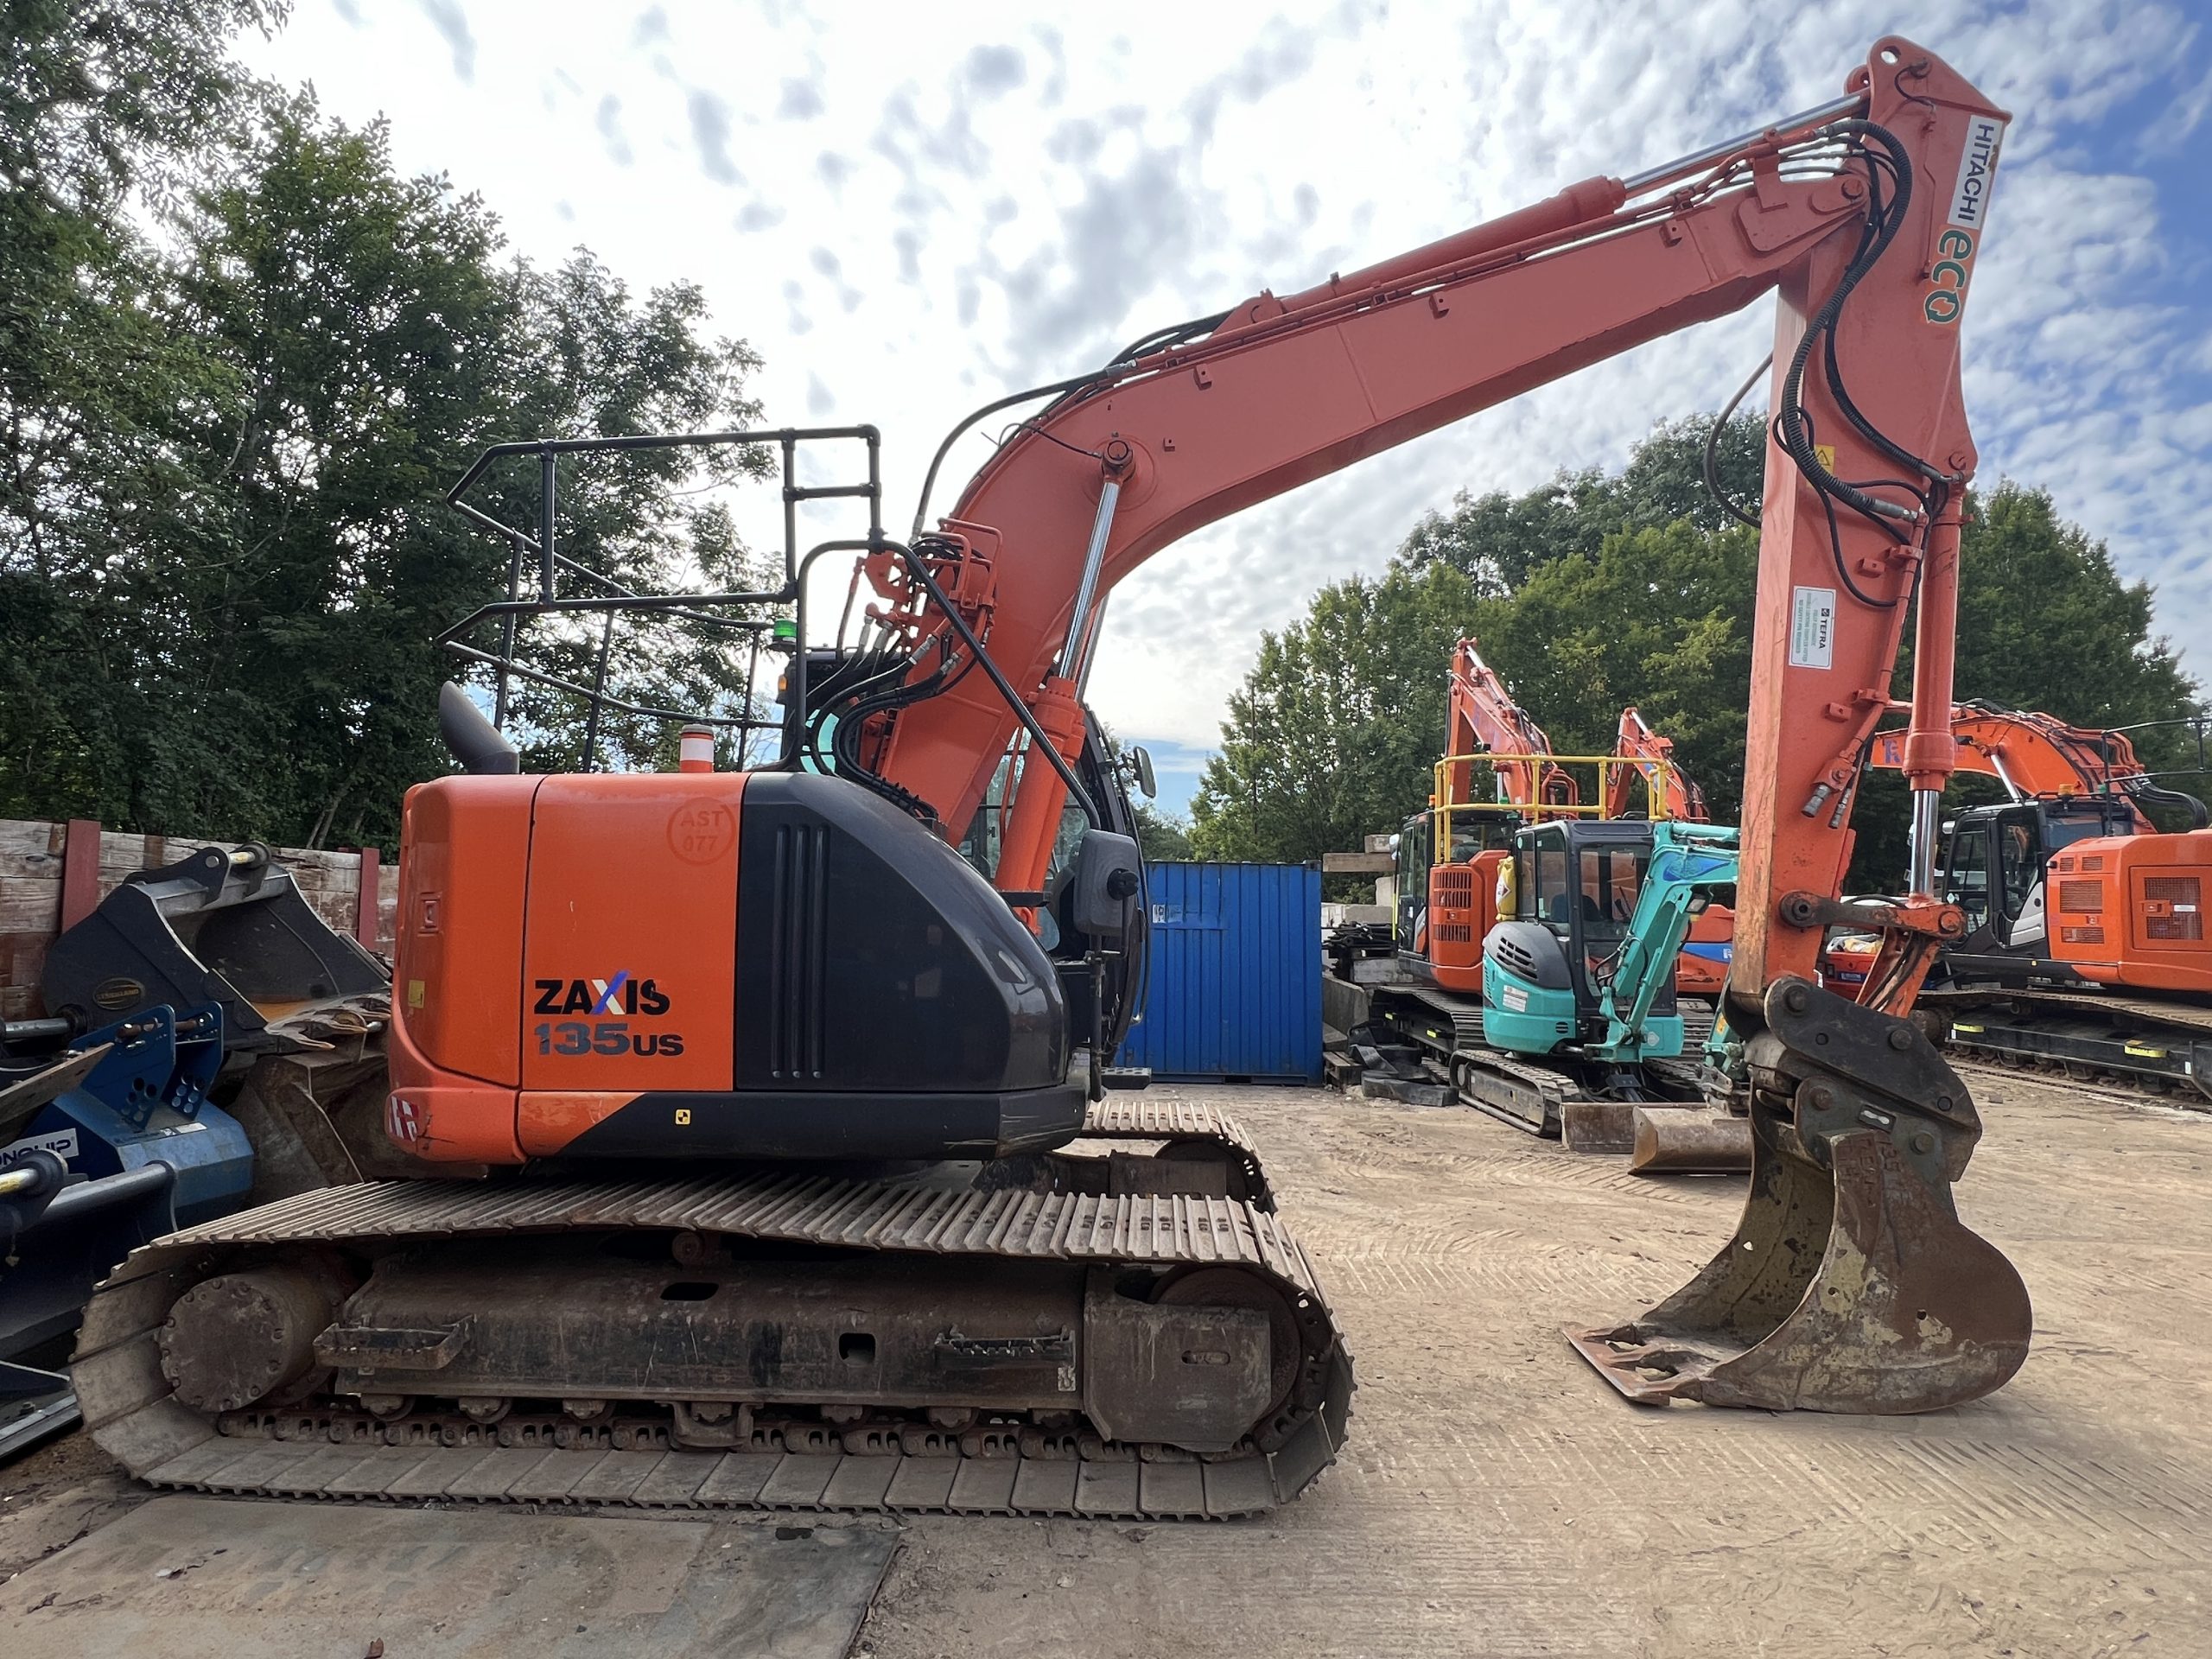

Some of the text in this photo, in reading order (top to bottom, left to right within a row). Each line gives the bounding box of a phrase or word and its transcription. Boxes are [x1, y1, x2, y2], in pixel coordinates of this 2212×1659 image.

[1958, 124, 1994, 221] HITACHI
[1819, 619, 1827, 649] TEFRA
[680, 810, 724, 827] AST
[683, 836, 719, 852] 077
[534, 969, 671, 1015] ZAXIS
